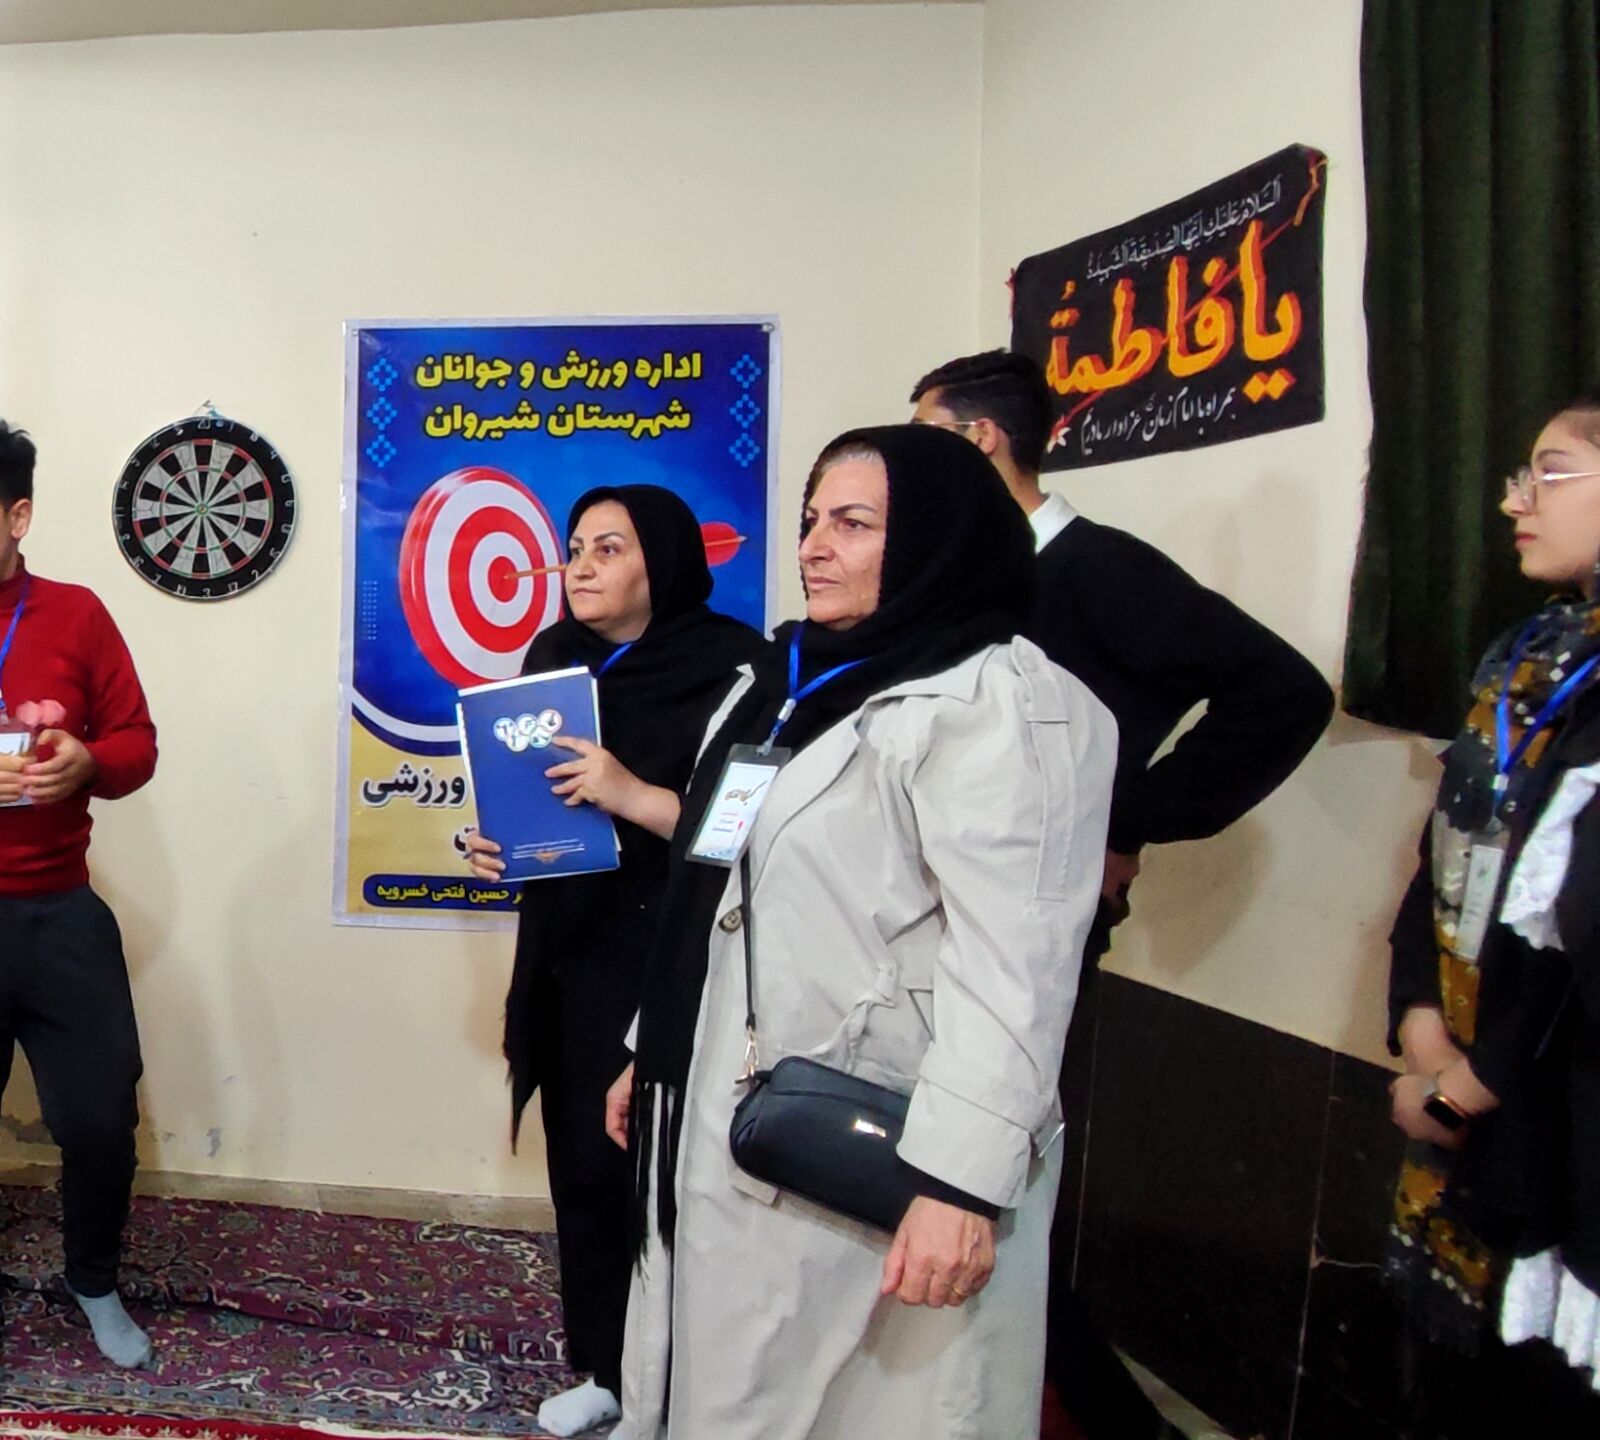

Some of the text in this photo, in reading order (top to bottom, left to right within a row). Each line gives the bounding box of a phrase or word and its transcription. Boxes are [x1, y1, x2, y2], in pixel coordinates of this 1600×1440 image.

[415, 349, 702, 390] اداره ورزش و جوانان
[425, 399, 691, 440] شهرستان شیروان
[363, 763, 466, 804] ورزشی
[377, 883, 428, 901] خسرویه
[431, 883, 466, 902] فتحی
[468, 888, 510, 903] حسین
